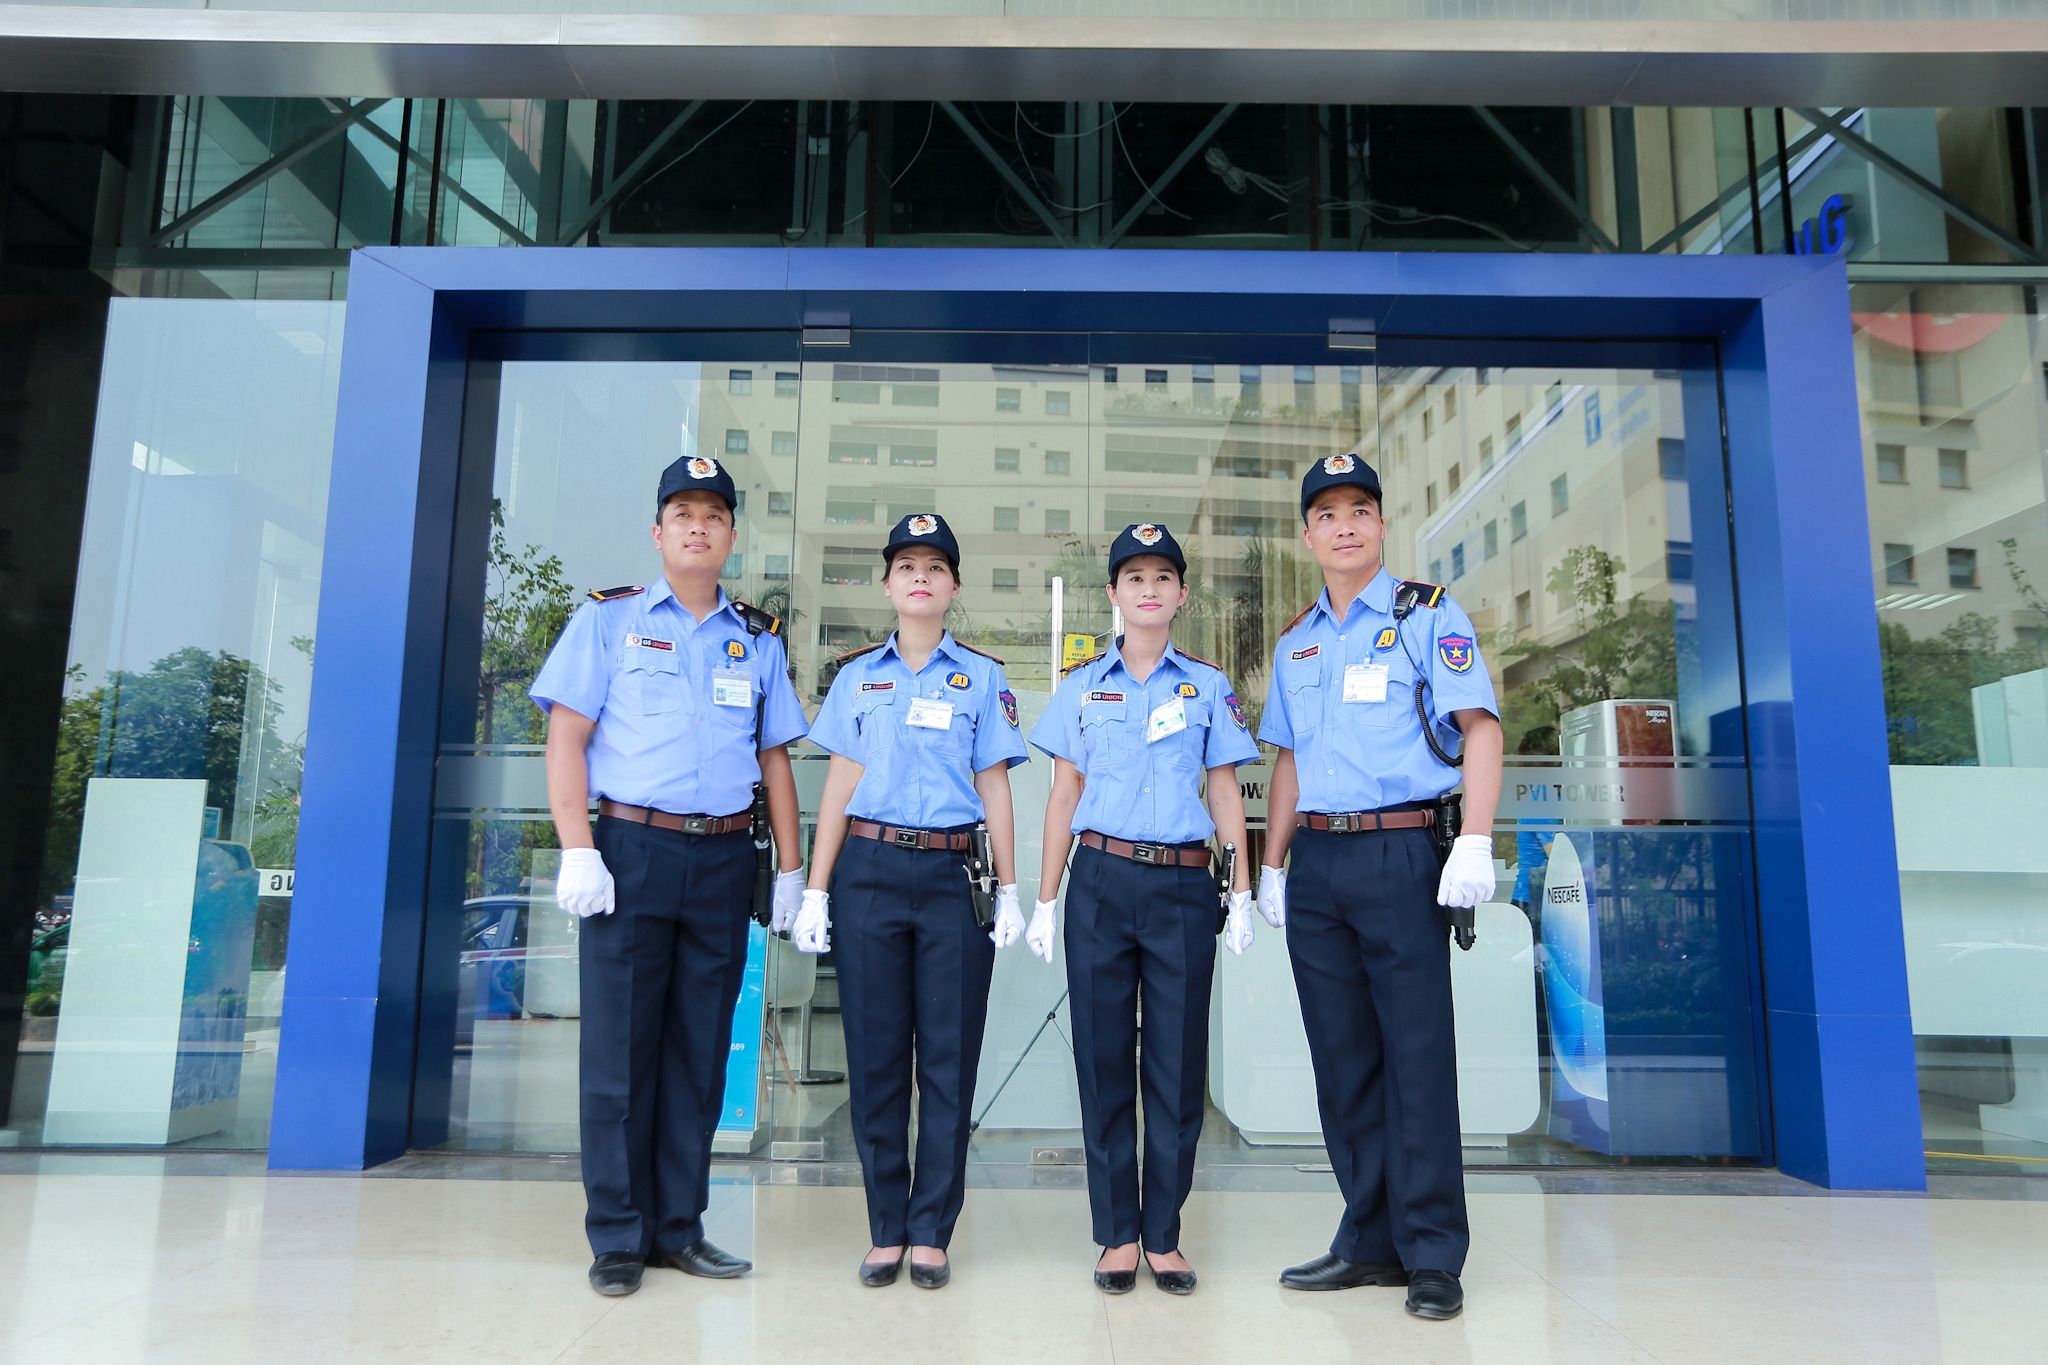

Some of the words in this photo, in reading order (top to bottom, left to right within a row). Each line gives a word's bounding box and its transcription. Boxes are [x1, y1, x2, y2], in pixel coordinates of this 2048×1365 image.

[1102, 694, 1123, 702] UNION
[1516, 784, 1547, 801] PVI
[1553, 784, 1625, 802] TOWER
[731, 1042, 745, 1051] 889
